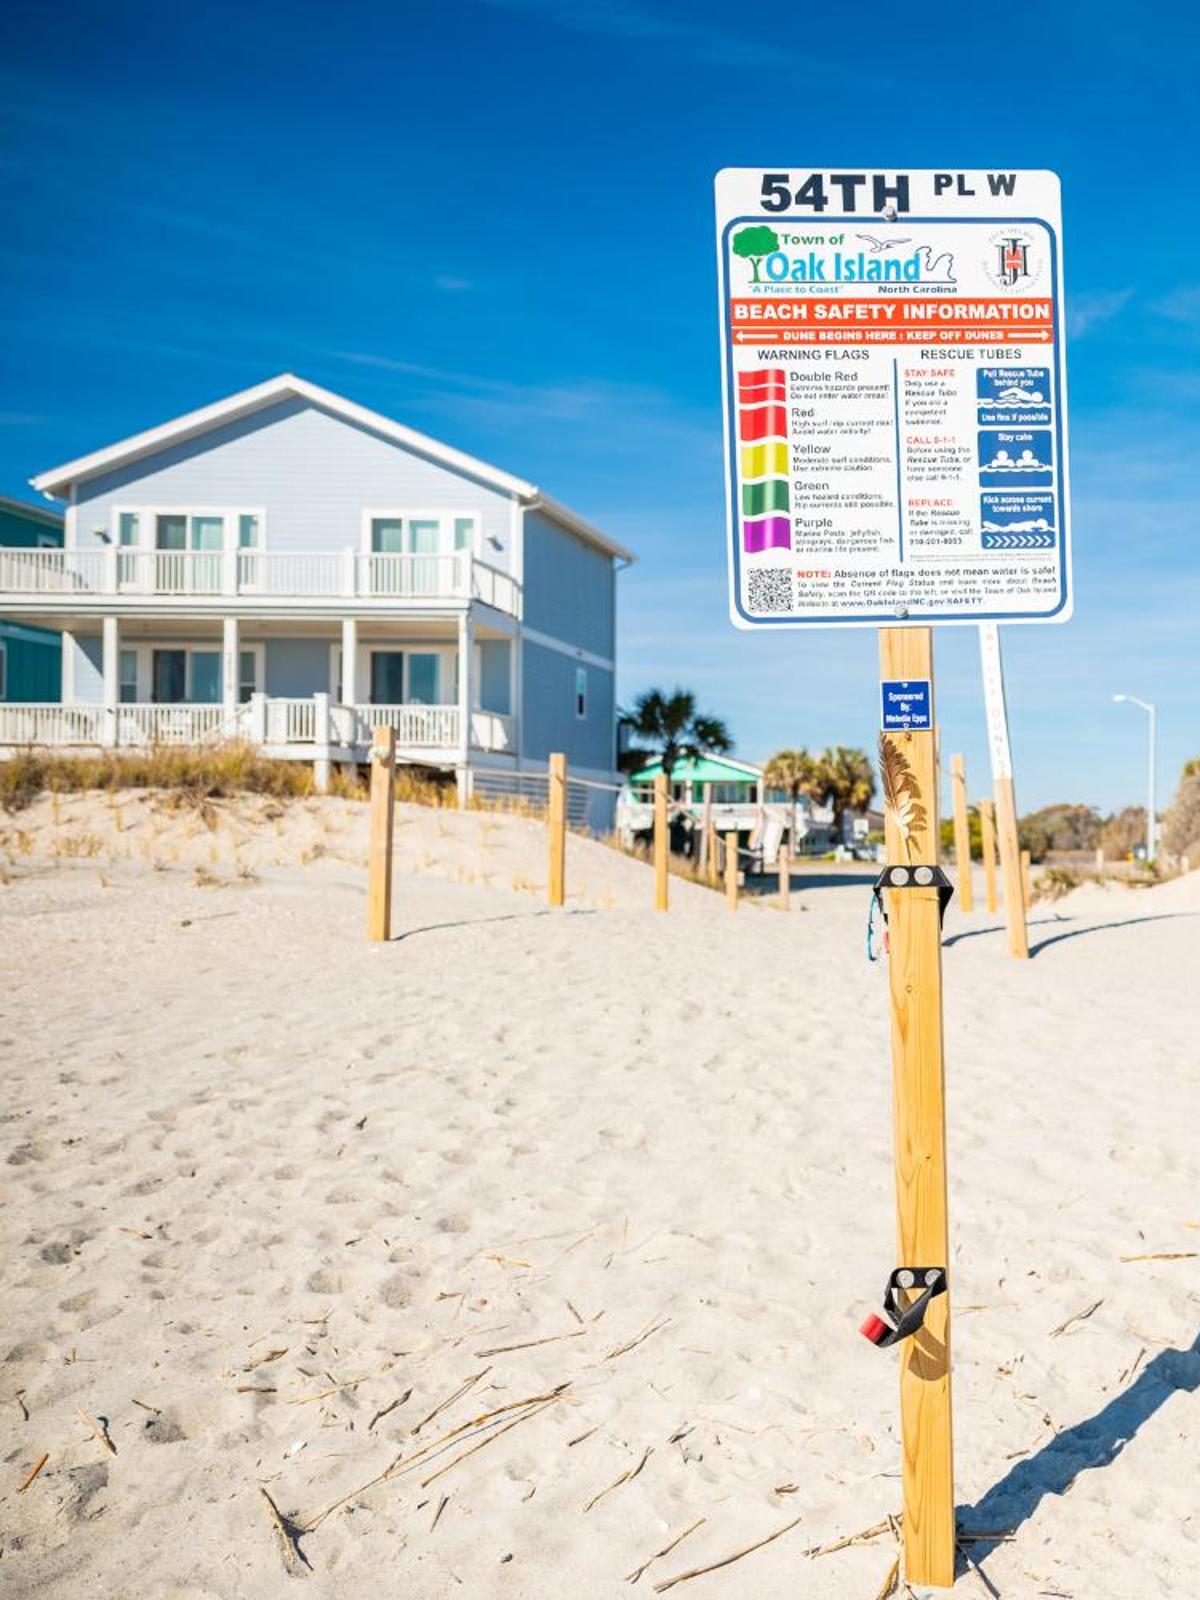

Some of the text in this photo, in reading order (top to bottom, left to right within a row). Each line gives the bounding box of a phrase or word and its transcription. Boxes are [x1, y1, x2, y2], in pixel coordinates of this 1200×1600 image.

[760, 174, 1016, 213] 54TH PL W
[781, 234, 845, 245] Town of
[766, 252, 920, 281] Oak Island
[764, 286, 791, 294] Place
[878, 285, 957, 294] North Carolina
[735, 303, 1050, 320] BEACH SAFETY INFORMATION
[784, 331, 1003, 340] DUNE BEGINS HERE KEEP OFF DUNES
[757, 350, 870, 360] WARNING FLAGS
[921, 349, 1022, 360] RESCUE TUBES
[790, 372, 858, 381] Double Red
[904, 368, 956, 377] STAY SAFE
[999, 370, 1026, 378] Rescue
[1028, 369, 1044, 378] Tube
[792, 408, 814, 417] Red
[982, 414, 996, 422] Use
[1018, 414, 1048, 422] possible
[998, 433, 1032, 442] Stay calm
[793, 444, 831, 454] Yellow
[794, 481, 829, 490] Green
[908, 498, 953, 506] REPLACE
[795, 518, 833, 529] Purple
[796, 570, 832, 578] NOTE:
[835, 570, 876, 578] Absence
[879, 569, 890, 577] of
[892, 569, 915, 578] flags
[918, 568, 942, 576] does
[888, 692, 924, 702] Sponsored
